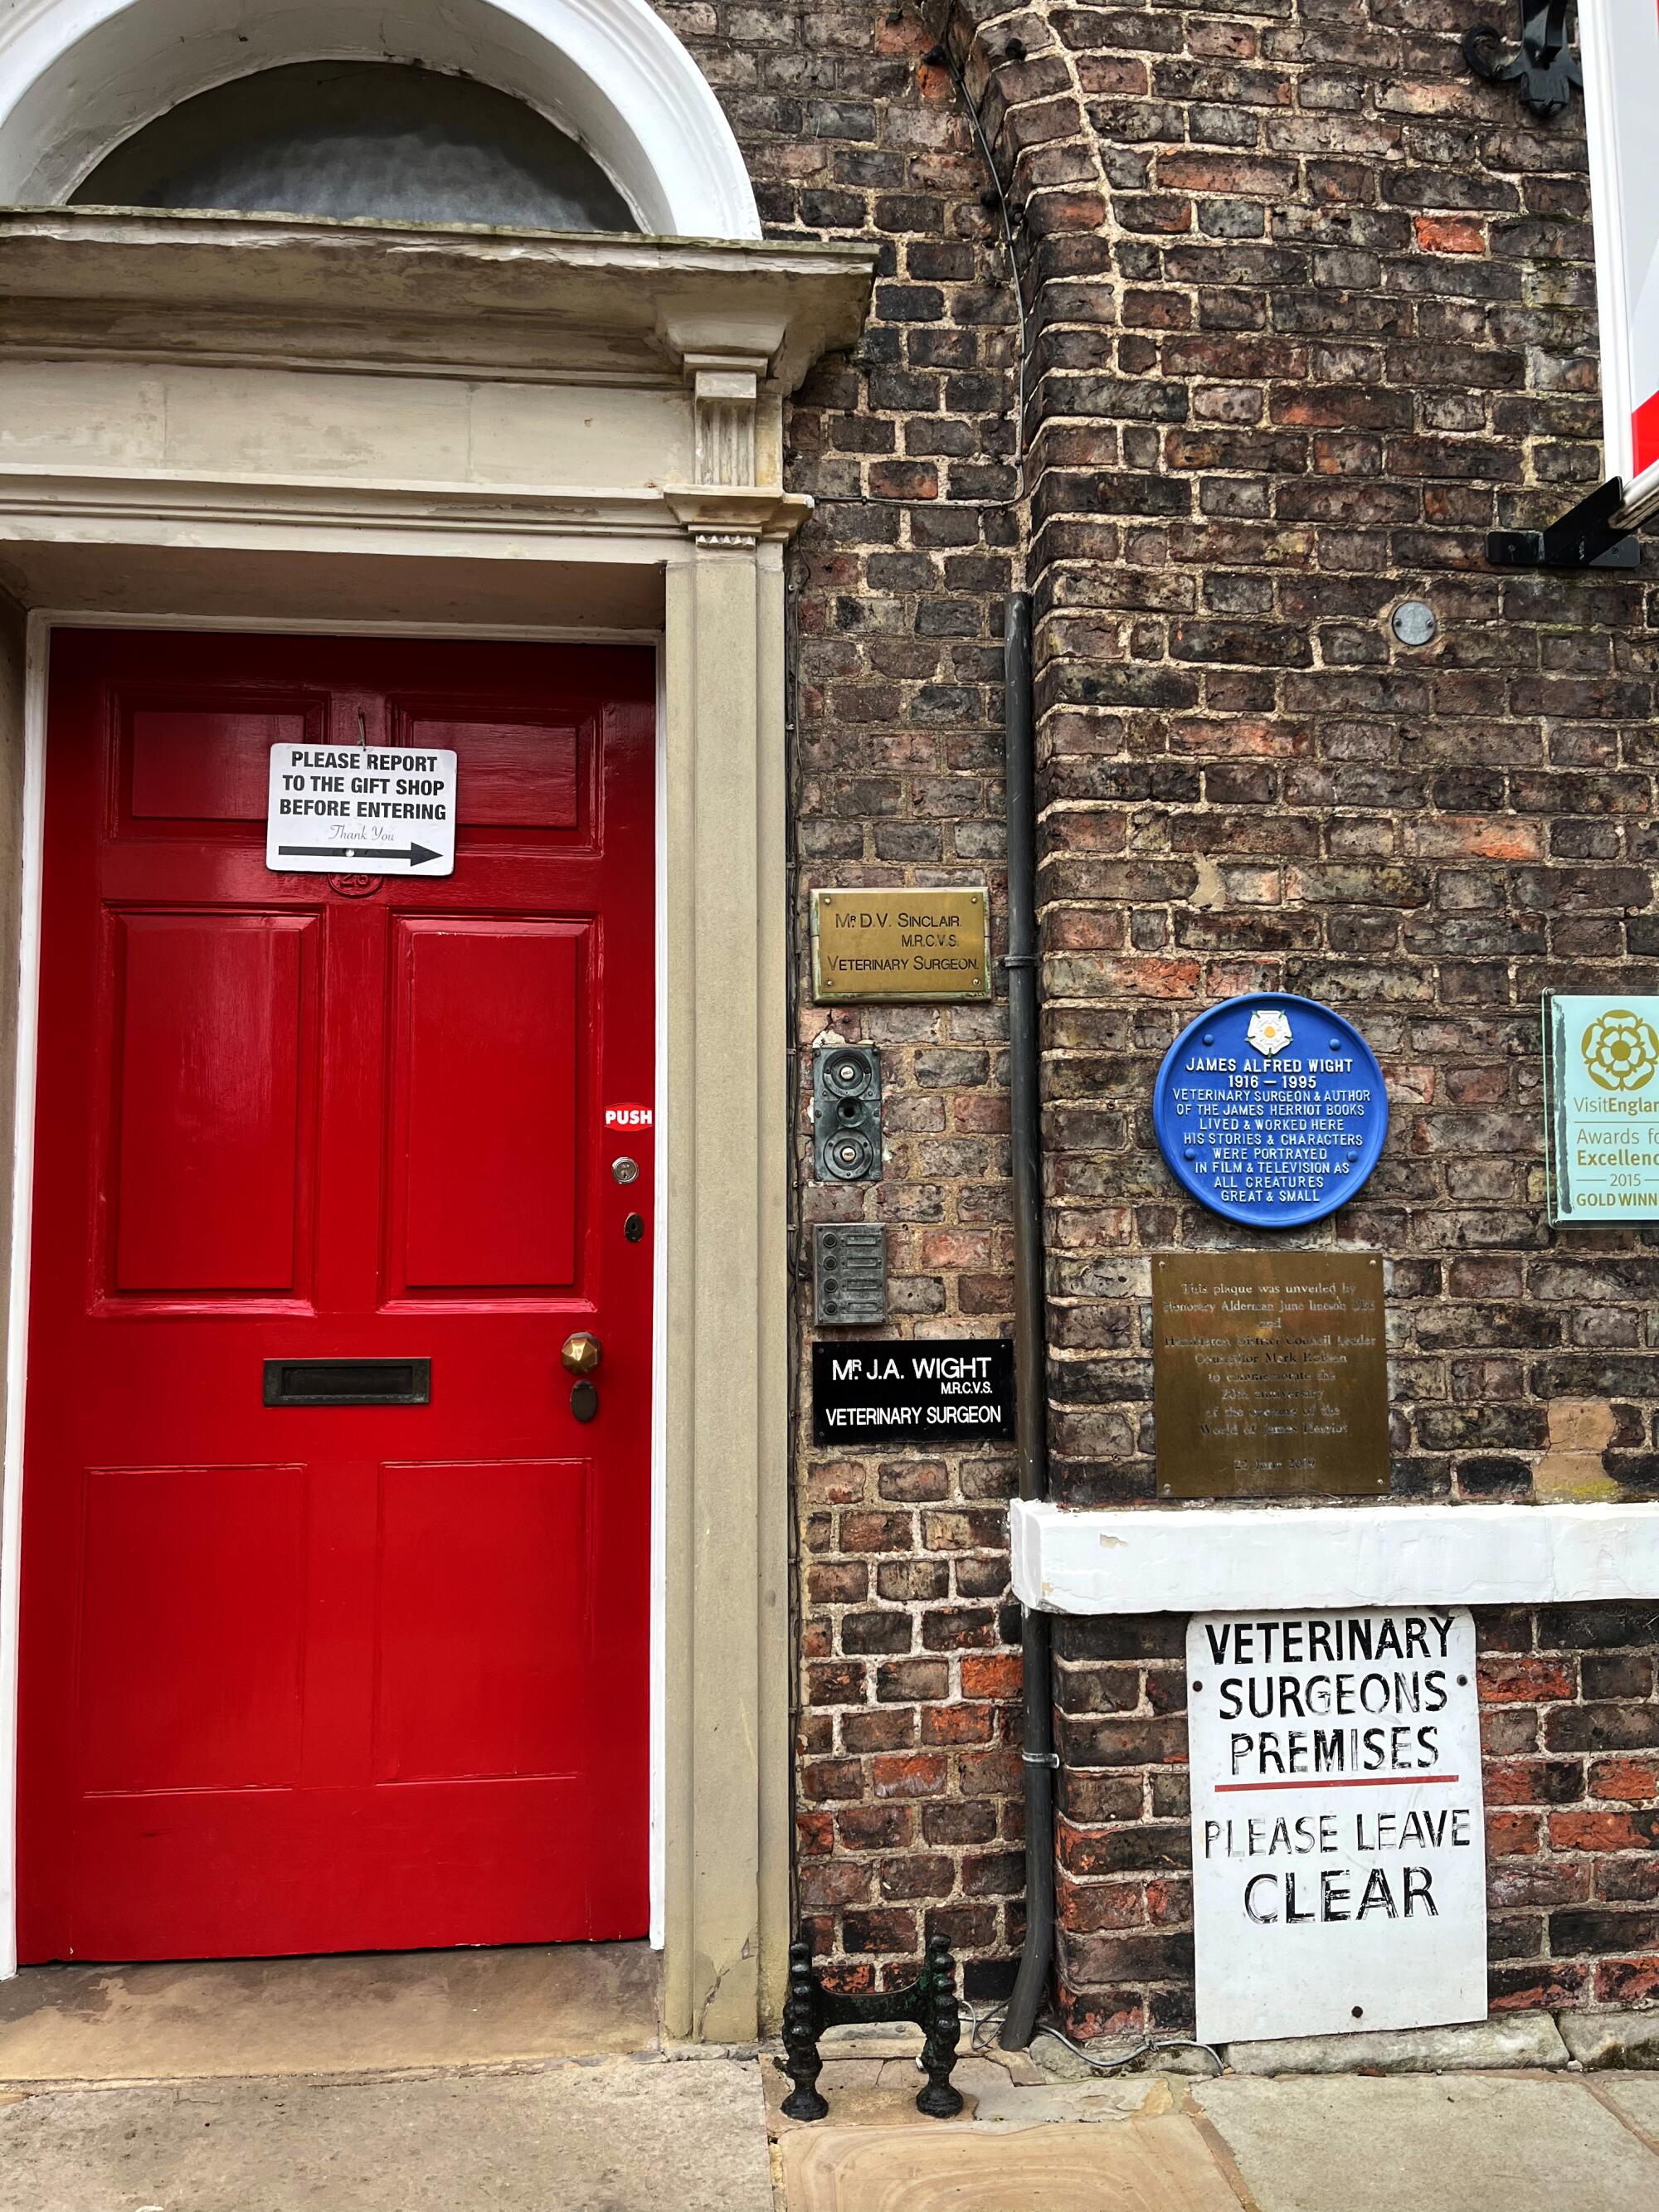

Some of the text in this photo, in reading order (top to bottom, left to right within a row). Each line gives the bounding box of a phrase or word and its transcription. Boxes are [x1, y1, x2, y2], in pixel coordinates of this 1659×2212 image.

[291, 751, 437, 772] PLEASE REPORT
[283, 775, 445, 796] TO THE GIFT SHOP
[280, 799, 446, 820] BEFORE ENTERING
[328, 824, 395, 842] Thank You
[1186, 1057, 1353, 1072] JAMES ALFRED WIGHT
[1228, 1075, 1259, 1089] 1916
[1282, 1075, 1316, 1089] 1995
[1173, 1088, 1370, 1103] VETERINARY SURGEON & AUTHOR
[1177, 1104, 1365, 1116] OF THE JAMES HERRIOT BOOKS
[606, 1110, 652, 1125] PUSH
[1199, 1118, 1345, 1131] LIVED & WORKED HERE
[1185, 1132, 1363, 1146] HIS STORIES & CHARACTERS
[1577, 1128, 1640, 1145] Awards
[1213, 1148, 1327, 1159] WERE PORTRAYED
[1195, 1162, 1350, 1174] IN FILM & TELEVISION AS
[1214, 1176, 1324, 1189] ALL CREATURES
[1609, 1174, 1642, 1187] 2015
[1221, 1190, 1321, 1203] GREAT & SMALL
[1577, 1193, 1616, 1207] GOLD
[1181, 1282, 1356, 1296] This plaque was unveiled by
[1221, 1300, 1274, 1311] Alderman
[1279, 1300, 1305, 1313] June
[1259, 1317, 1282, 1328] and
[1235, 1334, 1280, 1346] District
[1286, 1334, 1331, 1346] Council
[1265, 1352, 1297, 1364] Mark
[866, 1359, 905, 1380] J.A.
[912, 1357, 992, 1379] WIGHT
[1209, 1373, 1221, 1383] to
[1227, 1372, 1311, 1381] commemorate
[941, 1382, 993, 1394] M.R.C.V.S.
[825, 1405, 1001, 1427] VETERINARY SURGEON
[1321, 1405, 1340, 1417] the
[1200, 1422, 1238, 1435] World
[1262, 1423, 1297, 1437] James
[1204, 1616, 1455, 1665] VETERINARY
[1219, 1670, 1448, 1719] SURGEONS
[1231, 1725, 1439, 1775] PREMISES
[1204, 1809, 1470, 1859] PLEASE LEAVE
[1244, 1866, 1439, 1924] CLEAR
